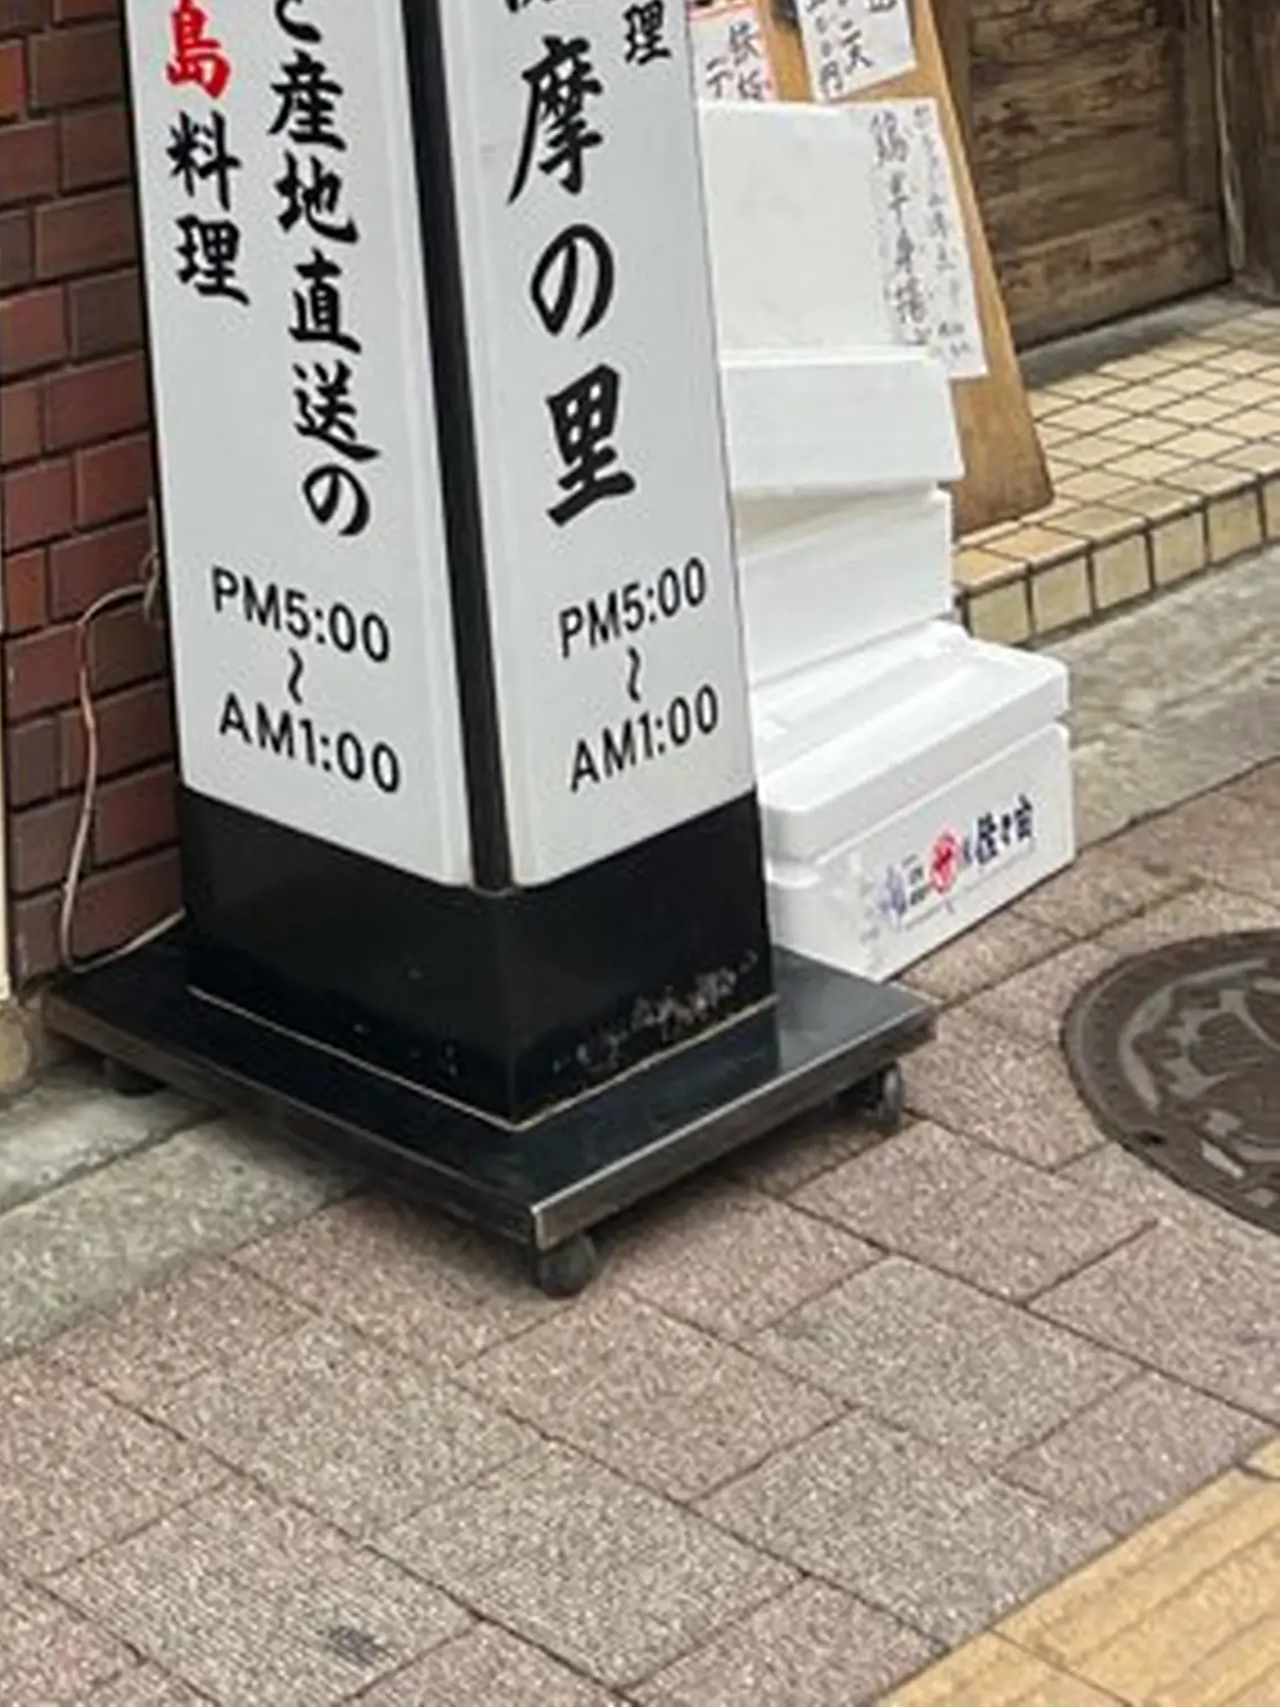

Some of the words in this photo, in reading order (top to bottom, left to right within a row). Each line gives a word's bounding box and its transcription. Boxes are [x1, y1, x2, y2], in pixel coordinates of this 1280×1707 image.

[211, 566, 391, 662] PM5:00
[558, 557, 707, 658] PM5:00
[218, 692, 400, 793] AM1:00
[570, 685, 720, 793] AM1:00
